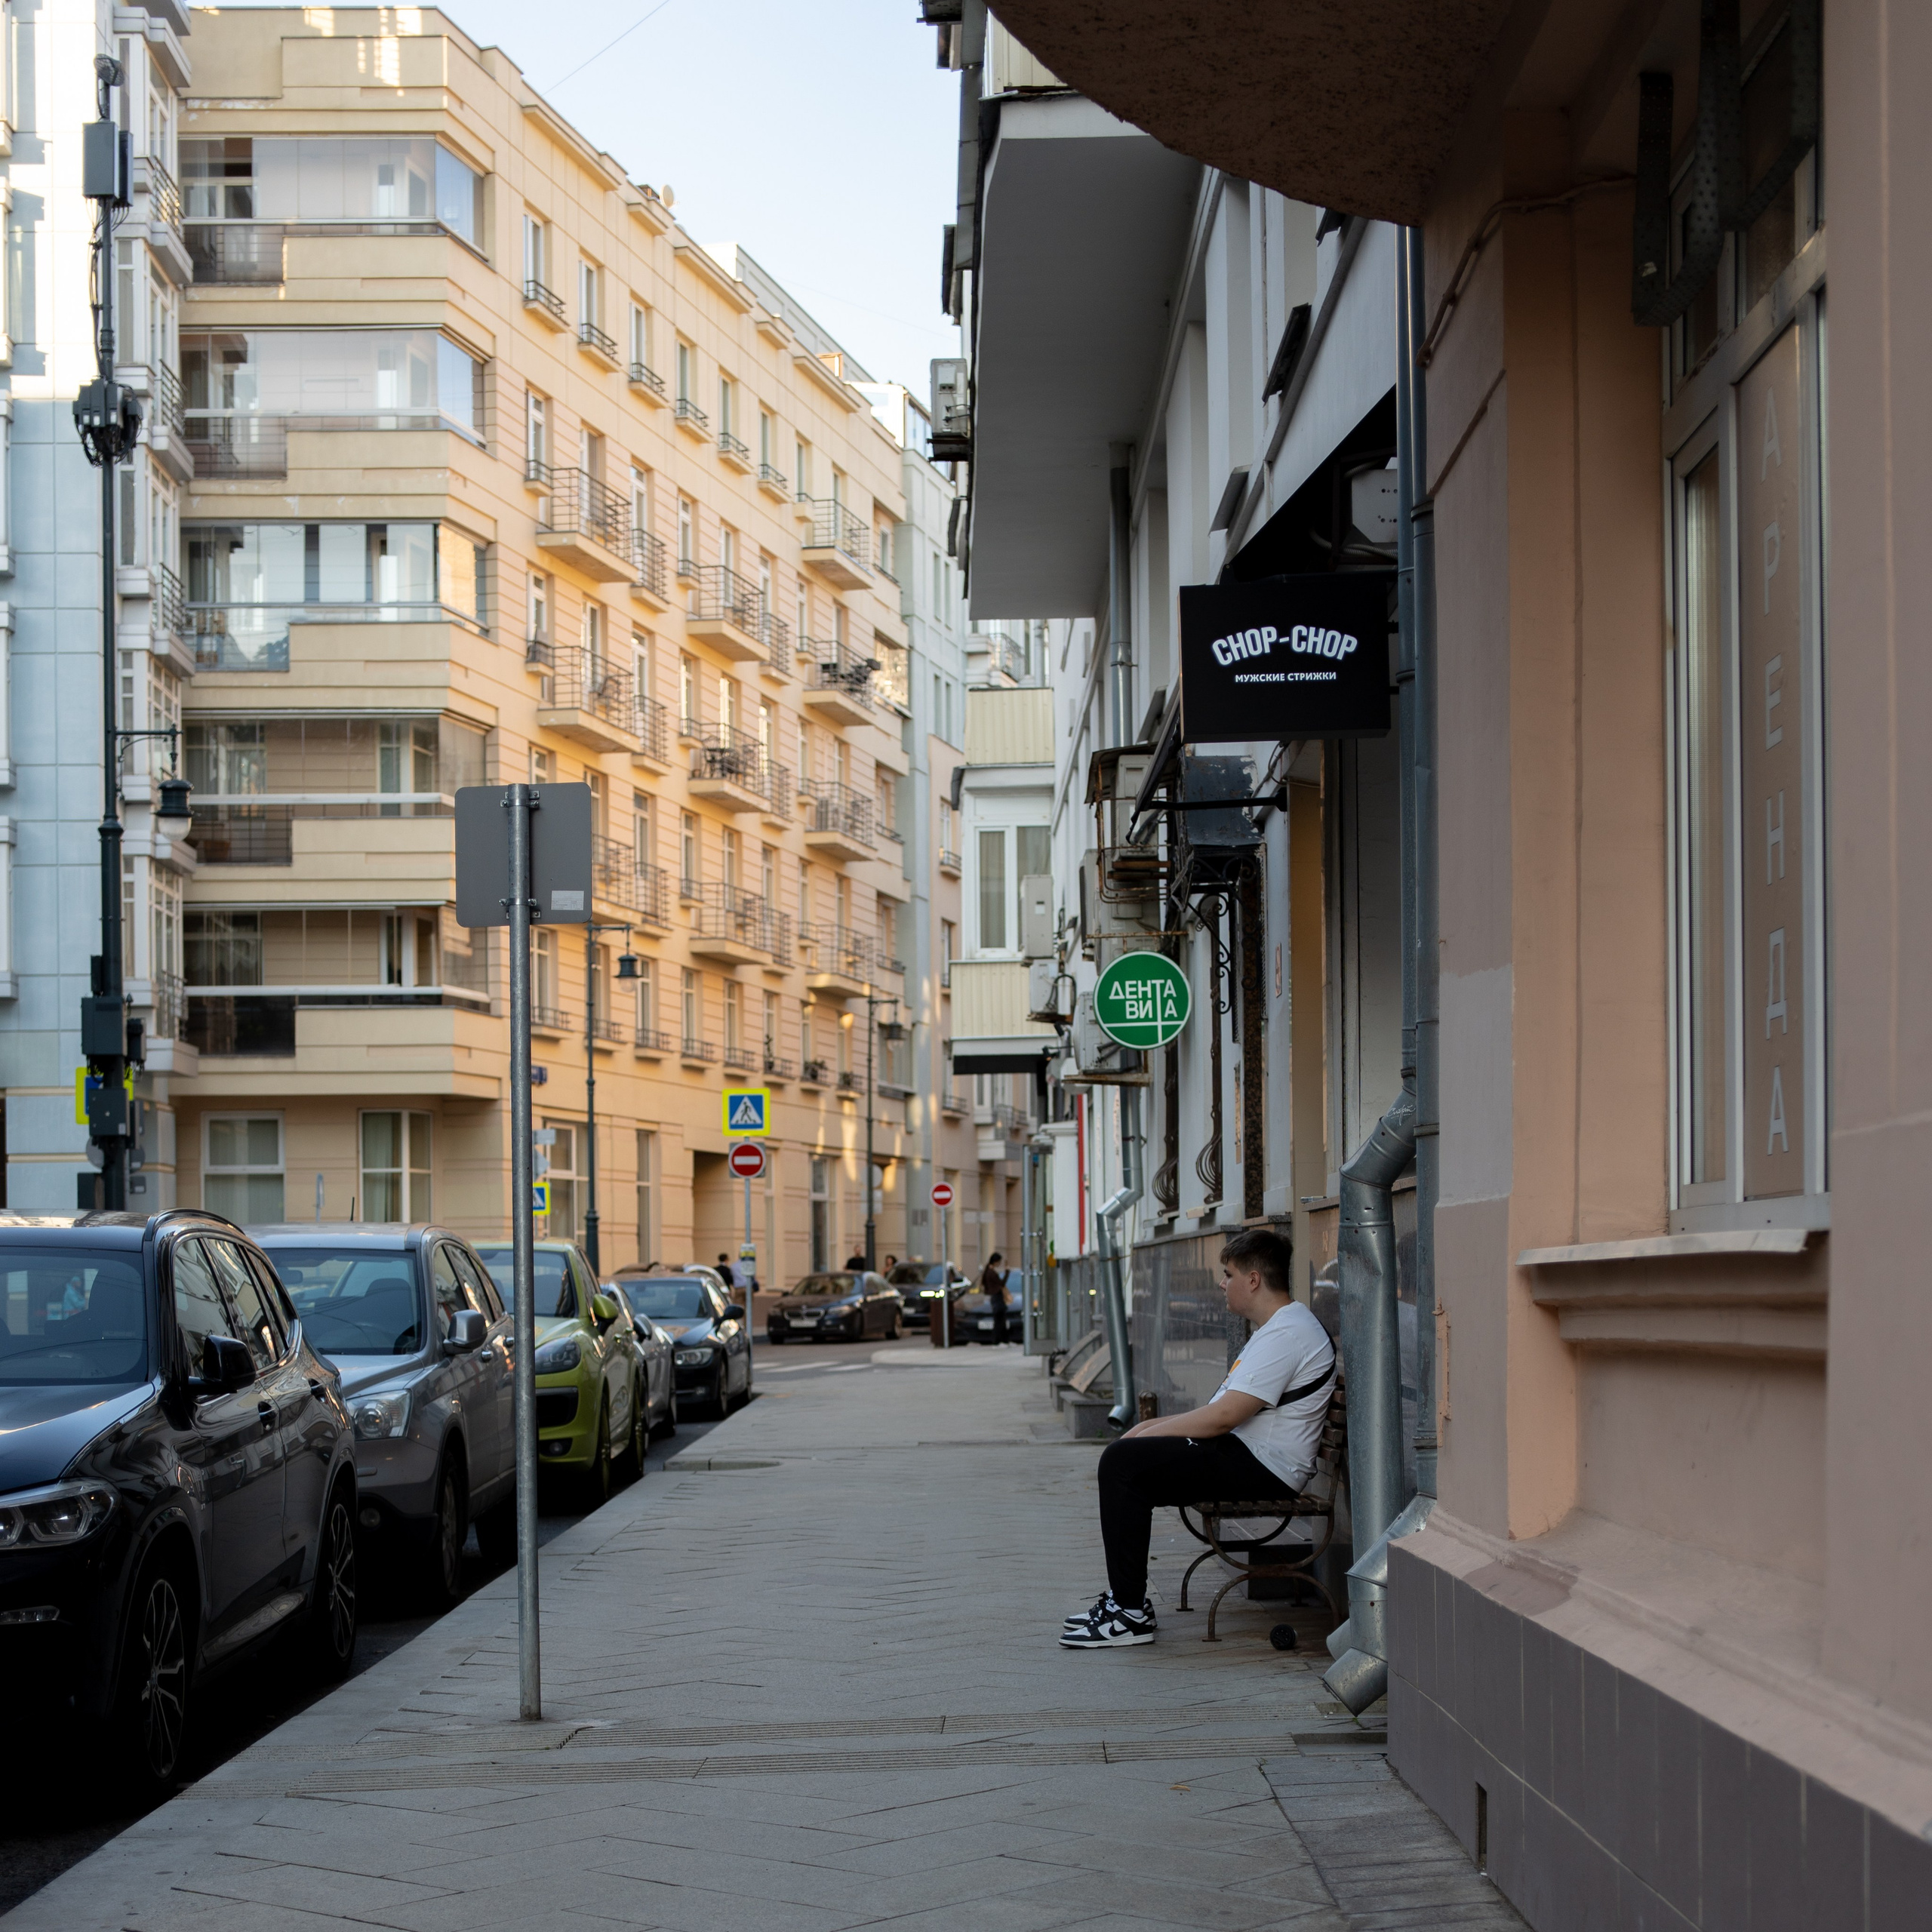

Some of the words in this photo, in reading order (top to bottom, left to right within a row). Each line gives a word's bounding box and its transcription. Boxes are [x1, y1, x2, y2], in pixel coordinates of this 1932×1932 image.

[1211, 625, 1358, 666] CHOP-CHOP
[1235, 672, 1285, 682] МУЖСКИЕ
[1287, 672, 1337, 681] СТРИЖКИ
[1761, 385, 1789, 1156] АРЕНДА
[1109, 979, 1177, 1000] ДЕНТА
